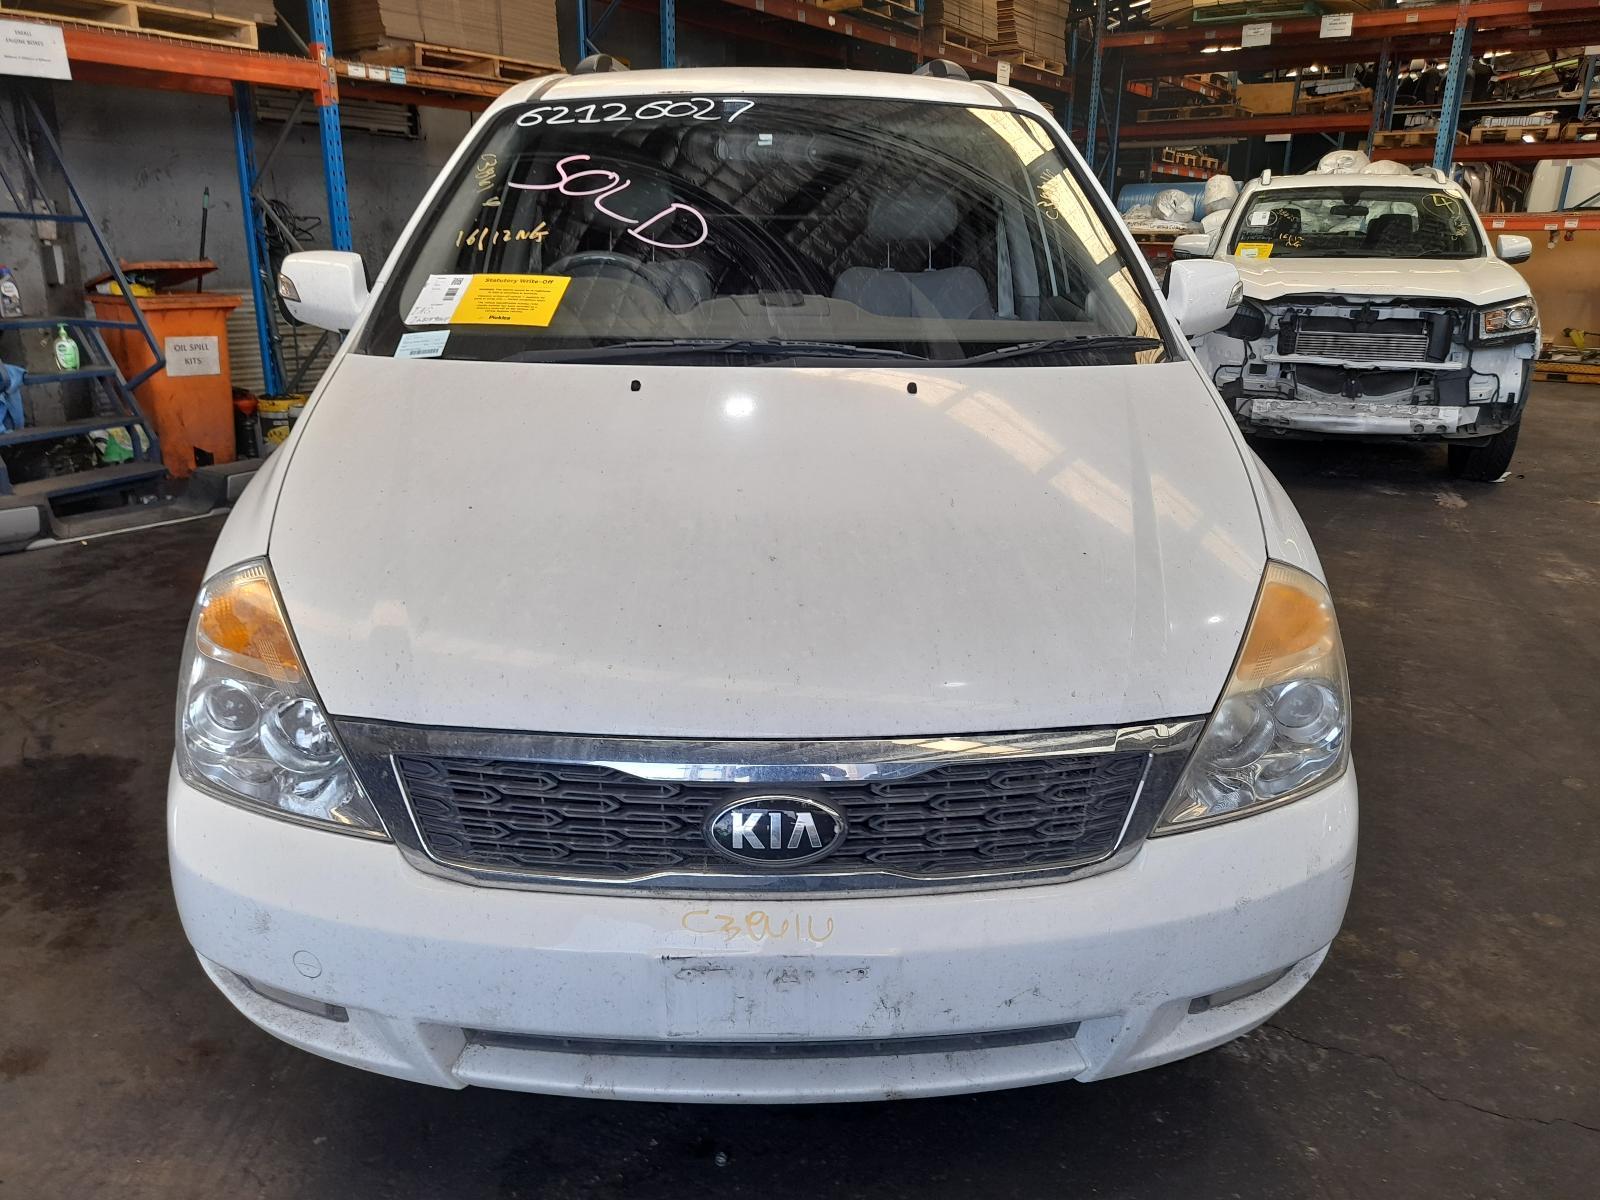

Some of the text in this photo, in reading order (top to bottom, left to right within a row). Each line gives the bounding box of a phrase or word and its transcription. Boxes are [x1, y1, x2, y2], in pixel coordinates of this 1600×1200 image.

[516, 97, 755, 127] 62126027
[507, 154, 709, 249] SOLD
[184, 357, 202, 365] KITS
[189, 343, 209, 351] SPILL
[731, 811, 823, 850] KIA
